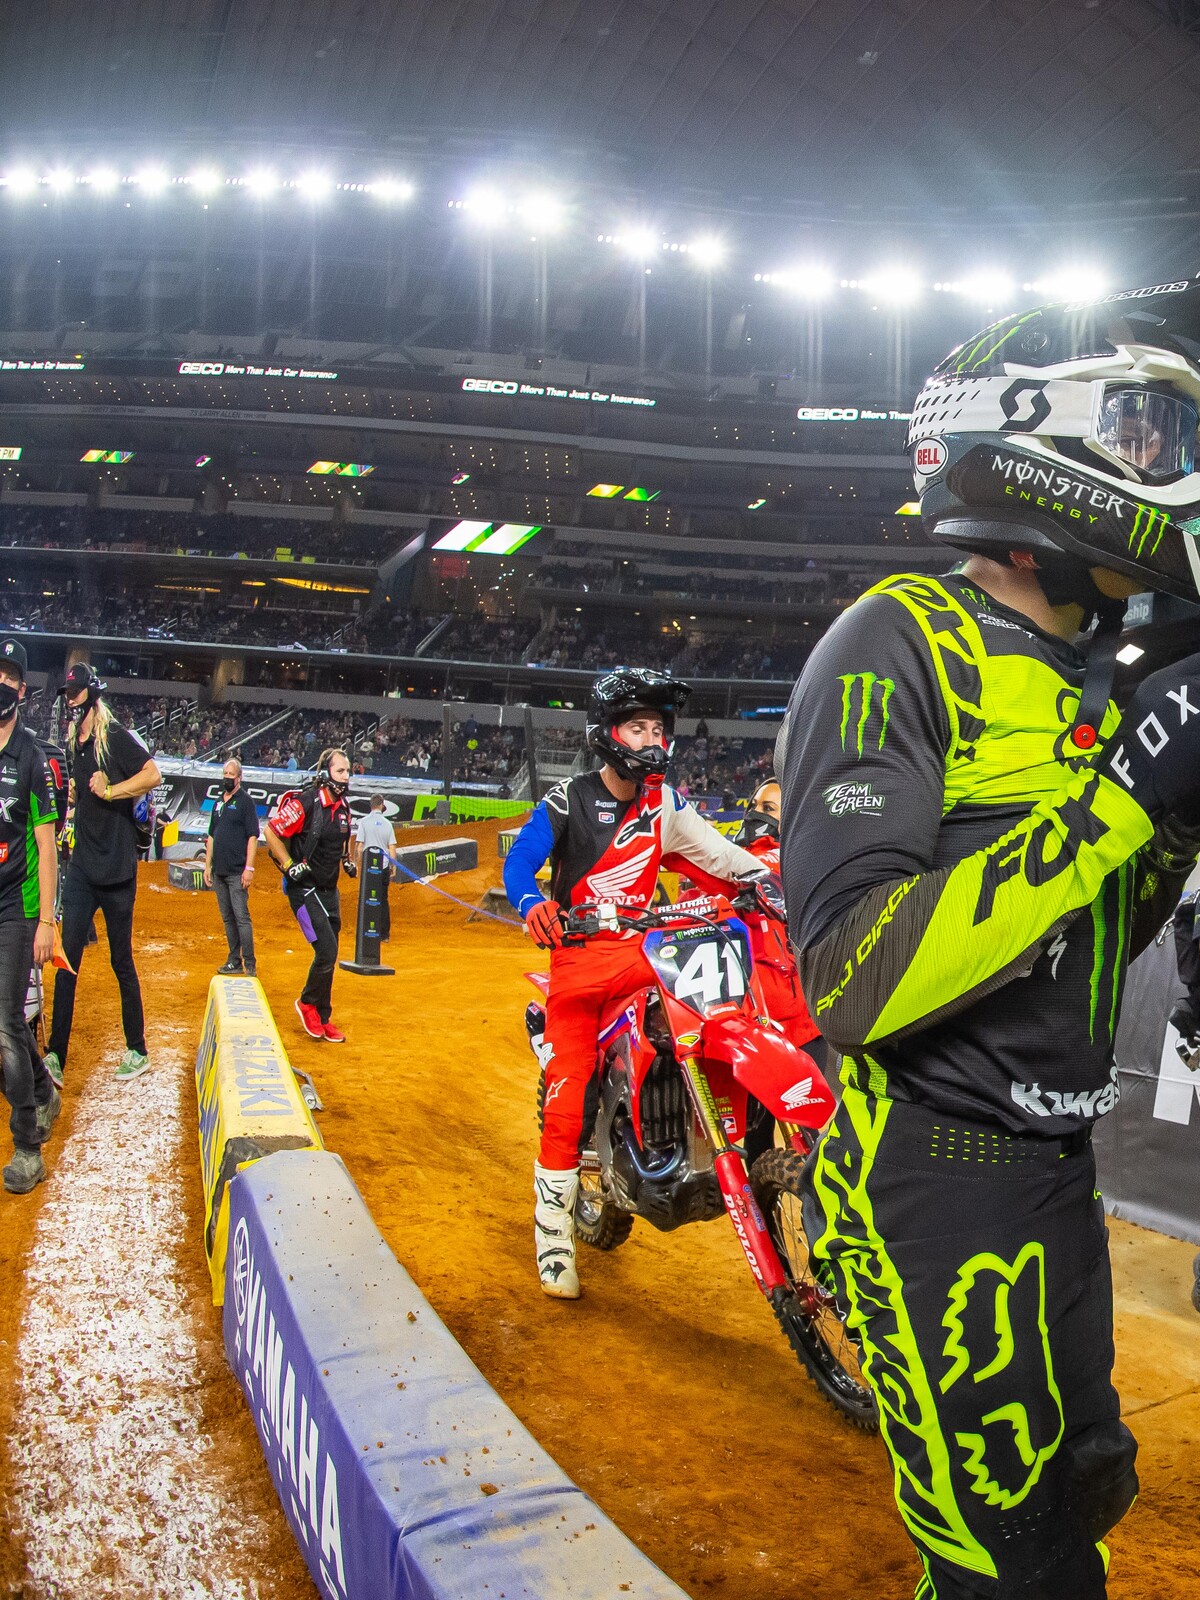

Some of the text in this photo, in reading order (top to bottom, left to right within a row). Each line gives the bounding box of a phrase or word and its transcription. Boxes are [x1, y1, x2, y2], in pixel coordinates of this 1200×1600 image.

[179, 363, 338, 379] GEICO More Than Just Car Insurance
[462, 378, 657, 407] GEICO More Than Just Car Insurance
[797, 406, 858, 422] GEICO
[860, 409, 887, 421] More
[916, 448, 941, 466] BELL
[992, 455, 1126, 518] MONSTER
[1005, 485, 1099, 525] ENERGY
[1110, 685, 1200, 789] FOX
[823, 782, 869, 803] TEAM
[831, 795, 883, 816] GREEN
[584, 893, 647, 907] HONDA
[657, 898, 712, 914] RENTHAL
[675, 940, 745, 1003] 41
[223, 978, 265, 1019] SUZUKI
[710, 1005, 737, 1016] HONDA
[231, 1034, 294, 1117] SUZUKI
[784, 1096, 827, 1111] HONDA
[723, 1192, 763, 1281] DUNLOP
[246, 1252, 348, 1589] YAMAHA
